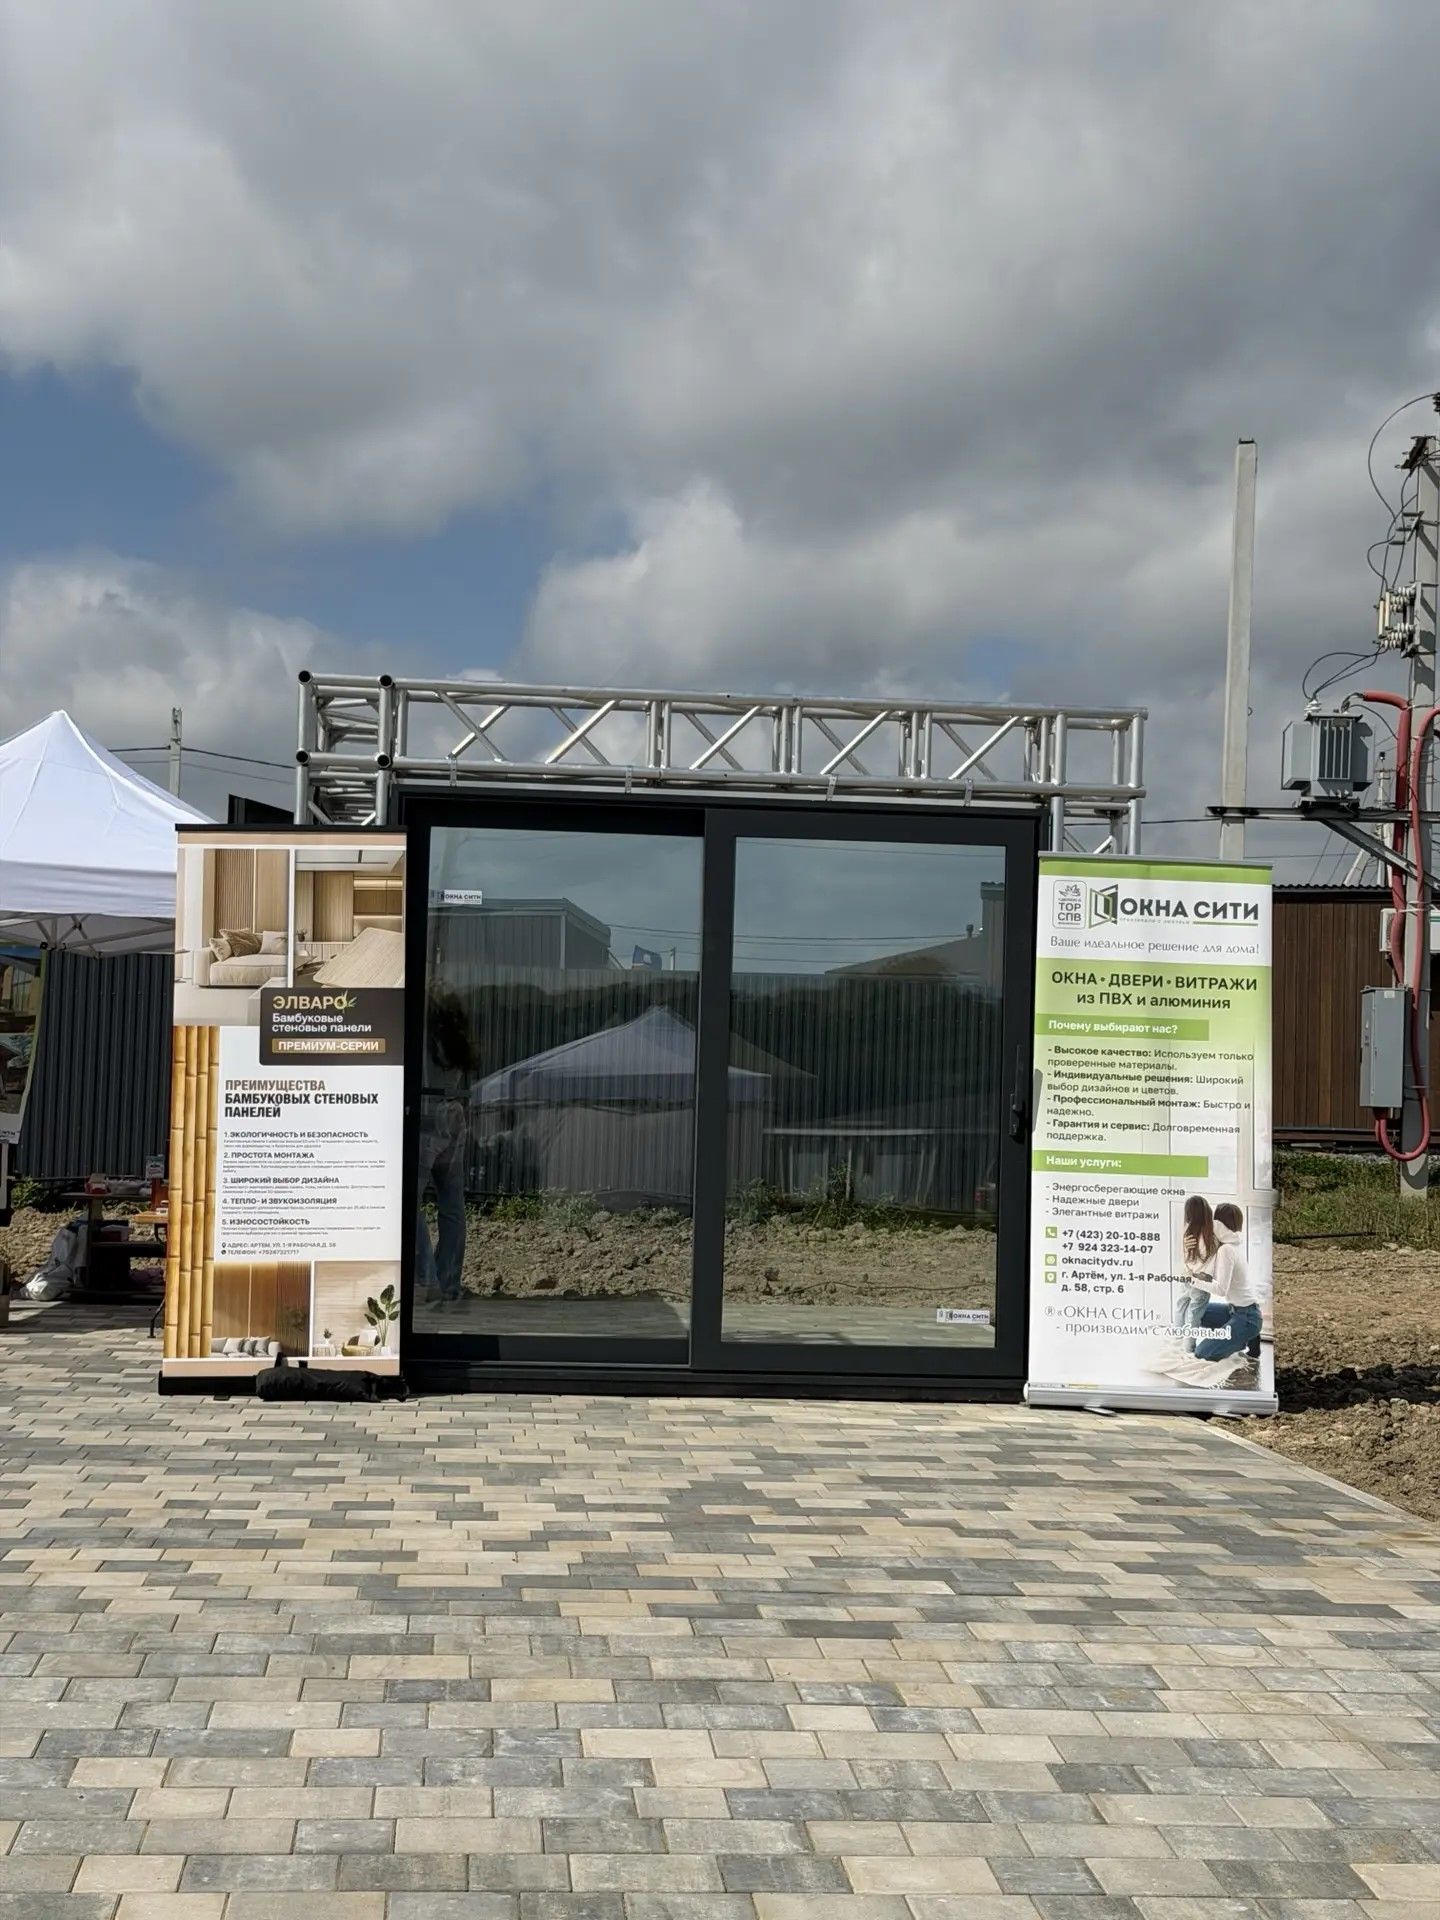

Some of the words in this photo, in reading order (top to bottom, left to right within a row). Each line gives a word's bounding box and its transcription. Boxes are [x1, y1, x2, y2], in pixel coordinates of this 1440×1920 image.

[1058, 902, 1081, 912] ТОР
[1120, 898, 1189, 917] ОКНА
[1193, 902, 1259, 920] СИТИ
[1057, 912, 1082, 922] СПВ
[1050, 936, 1080, 948] Ваше
[1084, 939, 1144, 950] идеальное
[1148, 942, 1199, 954] решение
[1202, 944, 1222, 954] для
[1225, 944, 1259, 955] дома!
[1052, 971, 1097, 985] ОКНА
[1109, 974, 1163, 988] ДВЕРИ
[1175, 977, 1257, 991] ВИТРАЖИ
[272, 994, 347, 1010] ЭЛВАРО
[1077, 994, 1094, 1004] из
[1100, 992, 1132, 1006] ПВХ
[1136, 996, 1146, 1006] и
[1150, 996, 1230, 1008] алюминия
[272, 1013, 343, 1024] Бамбуковые
[272, 1024, 327, 1033] стеновые
[330, 1023, 371, 1032] панели
[1049, 1020, 1091, 1032] Почему
[1094, 1022, 1150, 1033] выбирают
[1152, 1023, 1177, 1034] нас?
[278, 1041, 379, 1051] ПРЕМИУМ-СЕРИИ
[1054, 1046, 1099, 1055] Высокое
[1101, 1049, 1151, 1057] качество:
[1154, 1049, 1216, 1060] Используем
[1218, 1052, 1254, 1061] только
[1047, 1059, 1116, 1069] проверенные
[1118, 1061, 1177, 1070] материалы.
[1054, 1070, 1141, 1082] Индивидуальные
[1144, 1074, 1193, 1084] решения:
[1196, 1075, 1243, 1086] Широкий
[225, 1080, 326, 1092] ПРЕИМУЩЕСТВА
[1047, 1082, 1079, 1092] выбор
[1081, 1084, 1130, 1094] дизайнов
[1141, 1086, 1179, 1096] цветов.
[225, 1094, 311, 1105] БАМБУКОВЫХ
[314, 1093, 378, 1105] СТЕНОВЫХ
[1053, 1095, 1156, 1106] Профессиональный
[1158, 1099, 1201, 1109] монтаж:
[1203, 1100, 1241, 1110] Быстро
[225, 1104, 281, 1118] ПАНЕЛЕЙ
[1046, 1107, 1094, 1117] надежно.
[1052, 1120, 1100, 1129] Гарантия
[1110, 1122, 1150, 1132] сервис:
[1152, 1122, 1240, 1134] Долговременная
[1046, 1131, 1107, 1142] поддержка.
[1046, 1155, 1077, 1166] Наши
[1079, 1158, 1122, 1169] услуги:
[231, 1176, 271, 1184] ШИРОКИЙ
[301, 1176, 339, 1184] ДИЗАЙНА
[1053, 1183, 1158, 1195] Энергосберегающие
[1161, 1188, 1185, 1196] окна
[1053, 1195, 1106, 1205] Надежные
[1108, 1198, 1139, 1207] двери
[1052, 1207, 1112, 1218] Элегантные
[1115, 1211, 1159, 1219] витражи
[1062, 1229, 1074, 1239] +7
[1076, 1230, 1104, 1241] (423)
[1106, 1231, 1160, 1241] 20-10-888
[1062, 1242, 1074, 1251] +7
[1078, 1243, 1098, 1252] 924
[1100, 1244, 1153, 1253] 323-14-07
[1062, 1256, 1133, 1267] oknacitydv.ru
[1061, 1271, 1069, 1279] г.
[1071, 1270, 1108, 1281] Артём,
[1111, 1273, 1126, 1282] ул.
[1129, 1272, 1145, 1281] 1-я
[1147, 1274, 1195, 1285] Рабочая,
[1061, 1285, 1072, 1293] д.
[1075, 1284, 1091, 1294] 58,
[1093, 1285, 1115, 1294] стр.
[1117, 1285, 1124, 1294] 6
[1057, 1306, 1108, 1318] «ОКНА
[1112, 1308, 1161, 1321] СИТИ»
[1065, 1323, 1148, 1336] производим
[1152, 1327, 1160, 1336] с
[1164, 1324, 1232, 1339] любовью!
